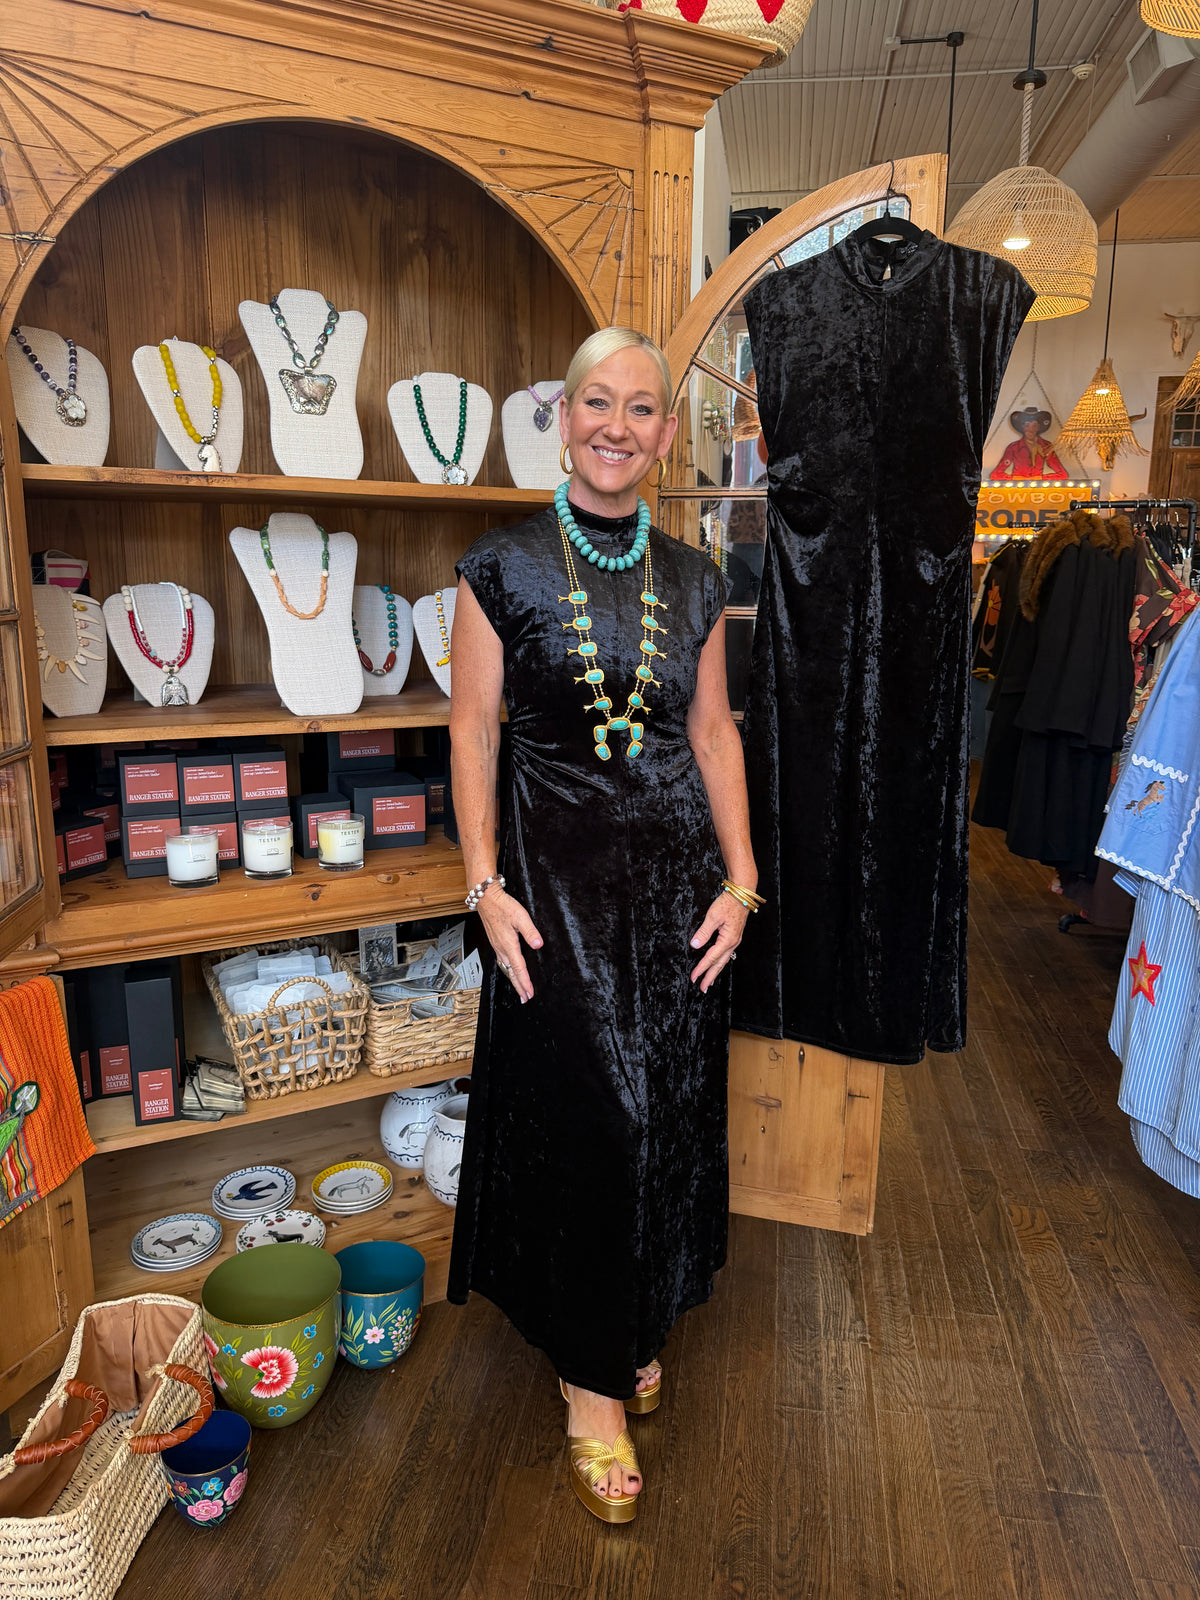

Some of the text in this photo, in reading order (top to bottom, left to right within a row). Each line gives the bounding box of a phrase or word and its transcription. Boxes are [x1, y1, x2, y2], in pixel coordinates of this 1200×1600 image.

[976, 509, 1066, 529] RODE
[129, 793, 151, 801] RANGER
[152, 791, 174, 800] STATION
[210, 793, 231, 801] STATION
[245, 790, 266, 798] RANGER
[266, 788, 286, 797] STATION
[376, 824, 396, 833] RANGER
[396, 823, 416, 832] STATION
[133, 849, 155, 858] RANGER
[105, 1073, 129, 1083] RANGER
[105, 1080, 129, 1089] STATION
[144, 1098, 169, 1108] RANGER
[145, 1105, 169, 1114] STATION
